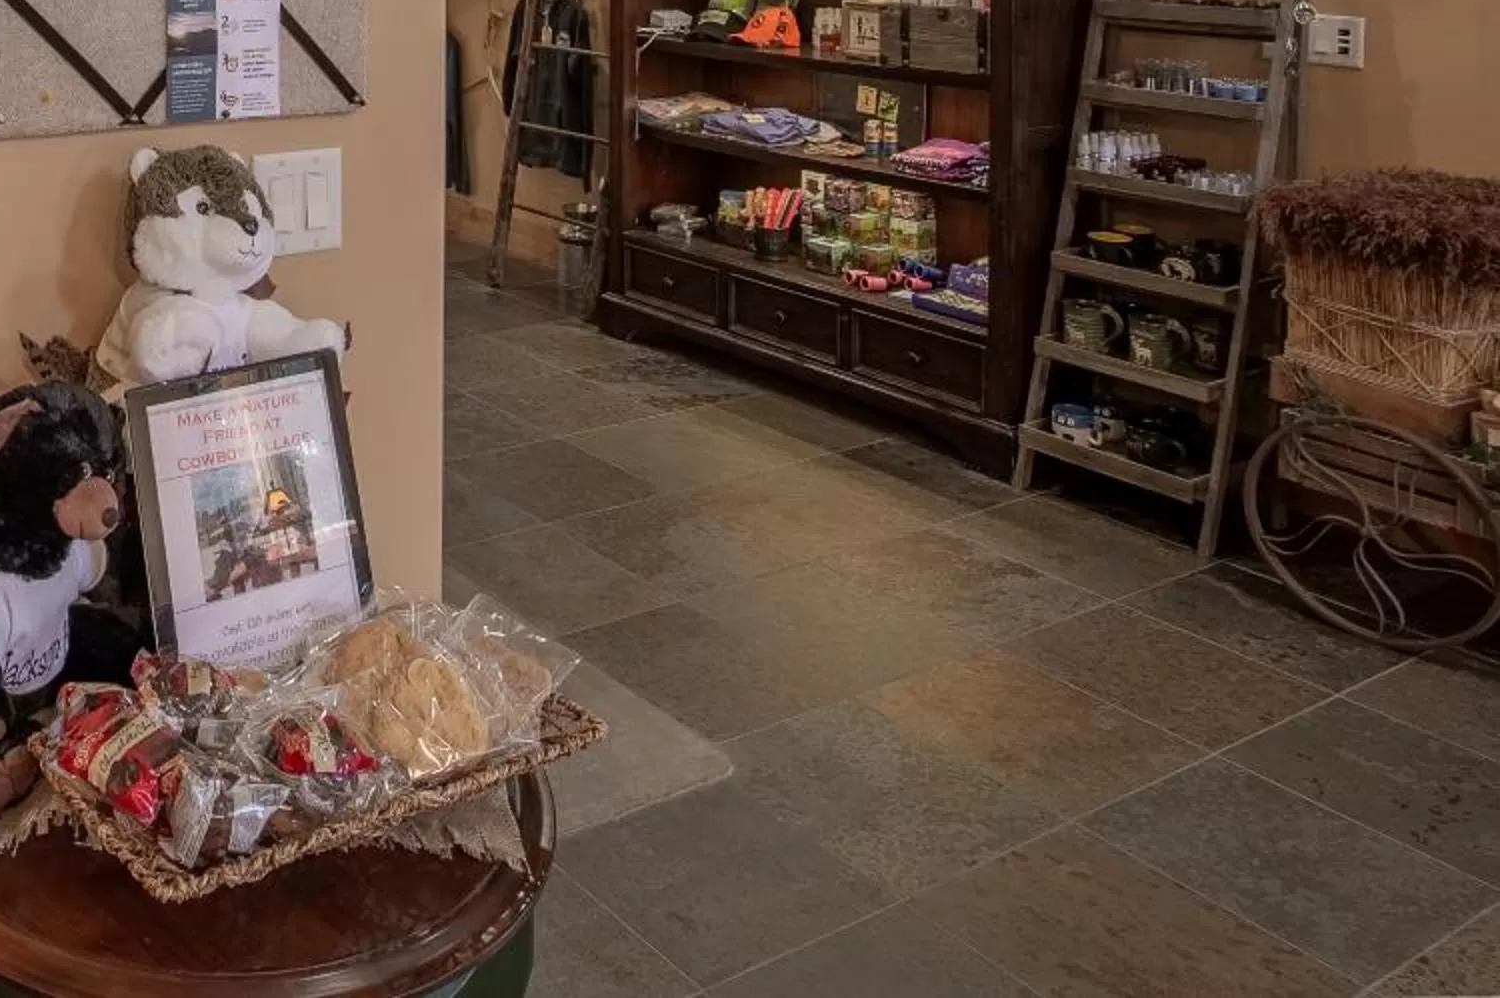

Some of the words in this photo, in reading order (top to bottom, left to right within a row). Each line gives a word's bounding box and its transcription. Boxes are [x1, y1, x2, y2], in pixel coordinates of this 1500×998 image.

[177, 409, 222, 427] MAKE
[243, 393, 301, 413] NATURE
[203, 419, 260, 444] FRIEND
[252, 432, 310, 452] ILLAGE
